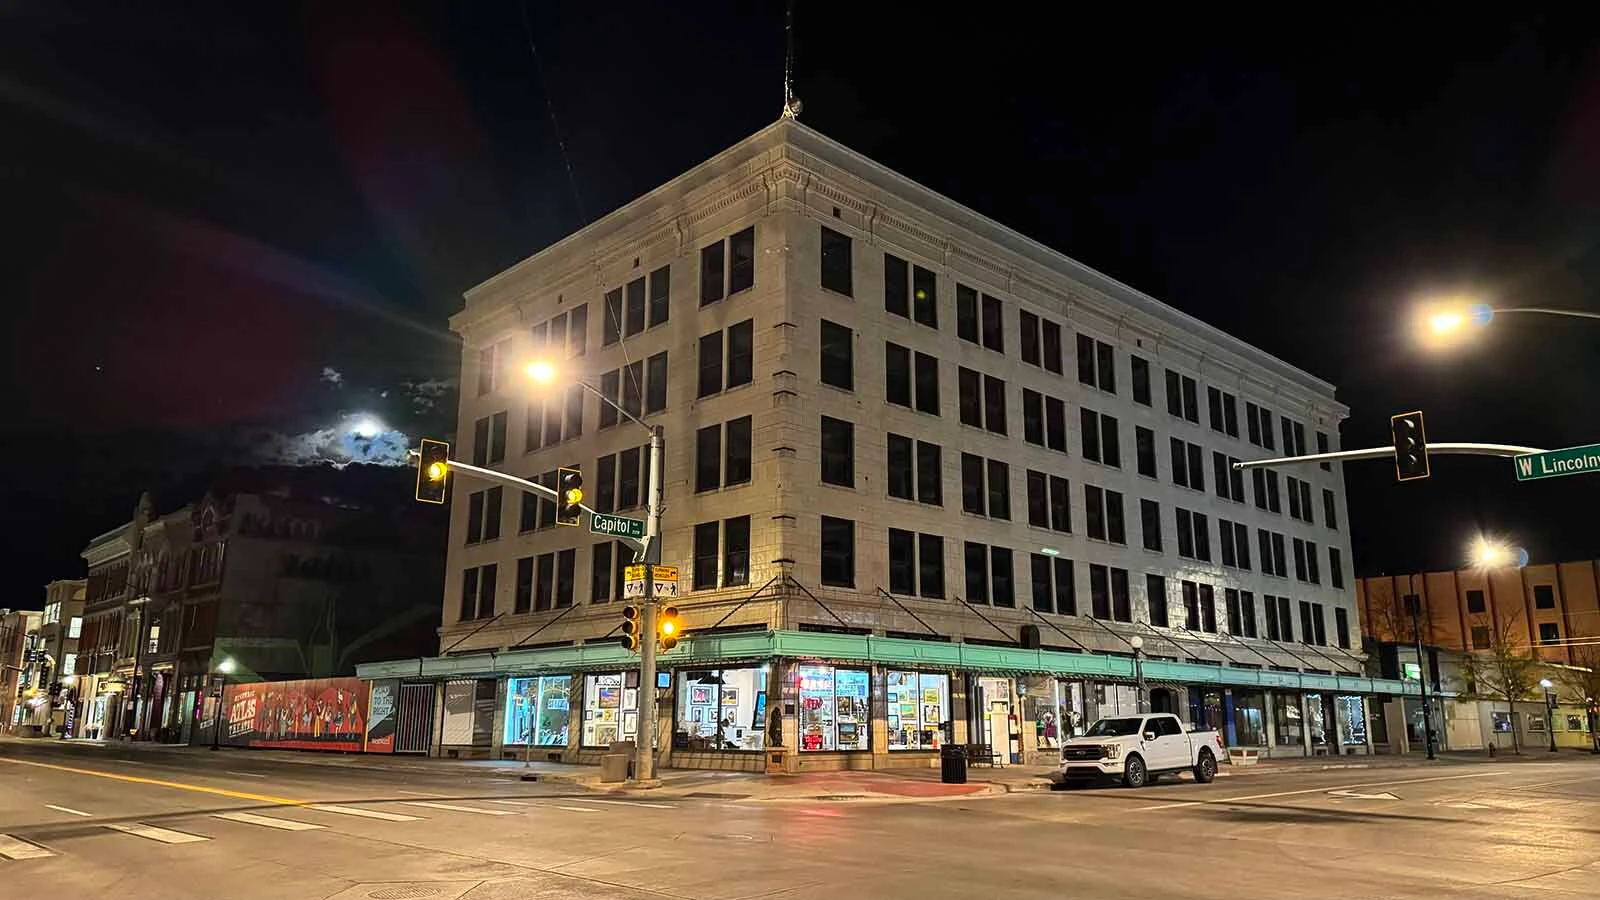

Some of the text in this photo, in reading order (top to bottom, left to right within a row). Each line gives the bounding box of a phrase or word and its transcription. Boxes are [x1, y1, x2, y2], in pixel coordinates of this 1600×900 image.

[1518, 457, 1532, 477] W
[594, 514, 630, 534] Capitol
[229, 699, 256, 723] ATLAS
